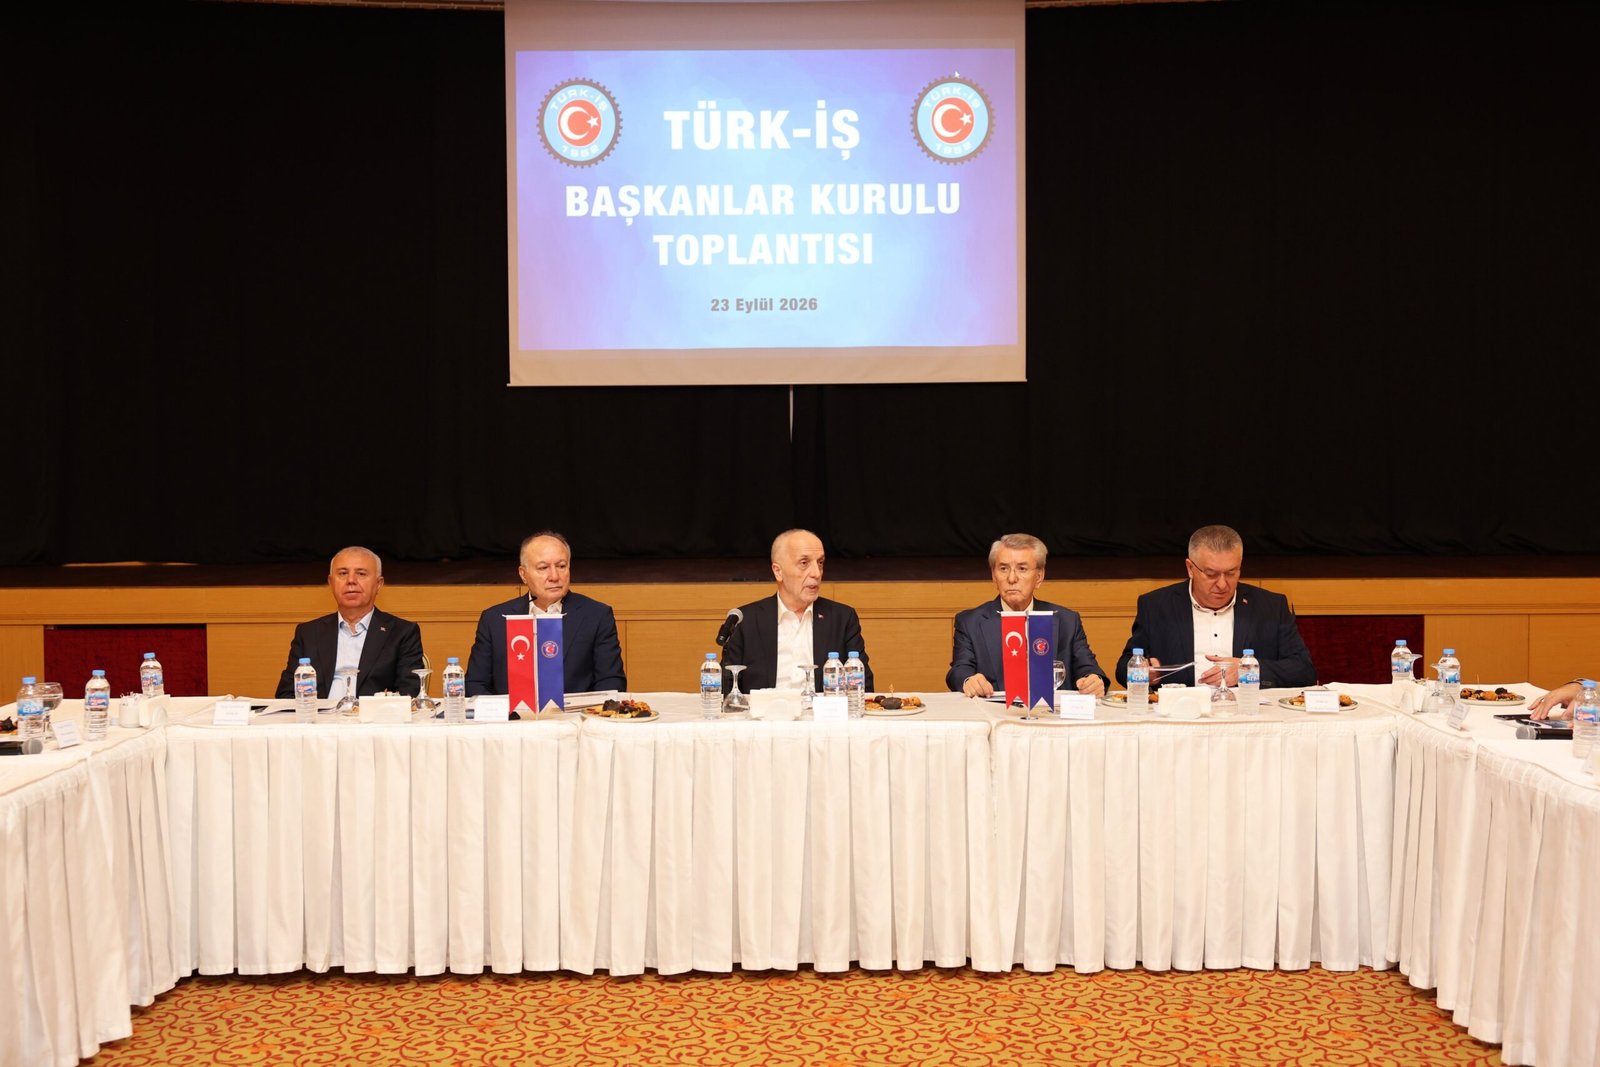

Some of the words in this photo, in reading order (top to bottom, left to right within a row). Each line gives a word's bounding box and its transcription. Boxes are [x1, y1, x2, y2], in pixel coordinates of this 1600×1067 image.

[664, 100, 860, 160] TÜRK-İŞ
[566, 184, 794, 226] BAŞKANLAR
[811, 183, 961, 217] KURULU
[653, 233, 873, 267] TOPLANTISI
[711, 298, 729, 312] 23
[736, 298, 773, 314] Eylül
[779, 297, 818, 311] 2026
